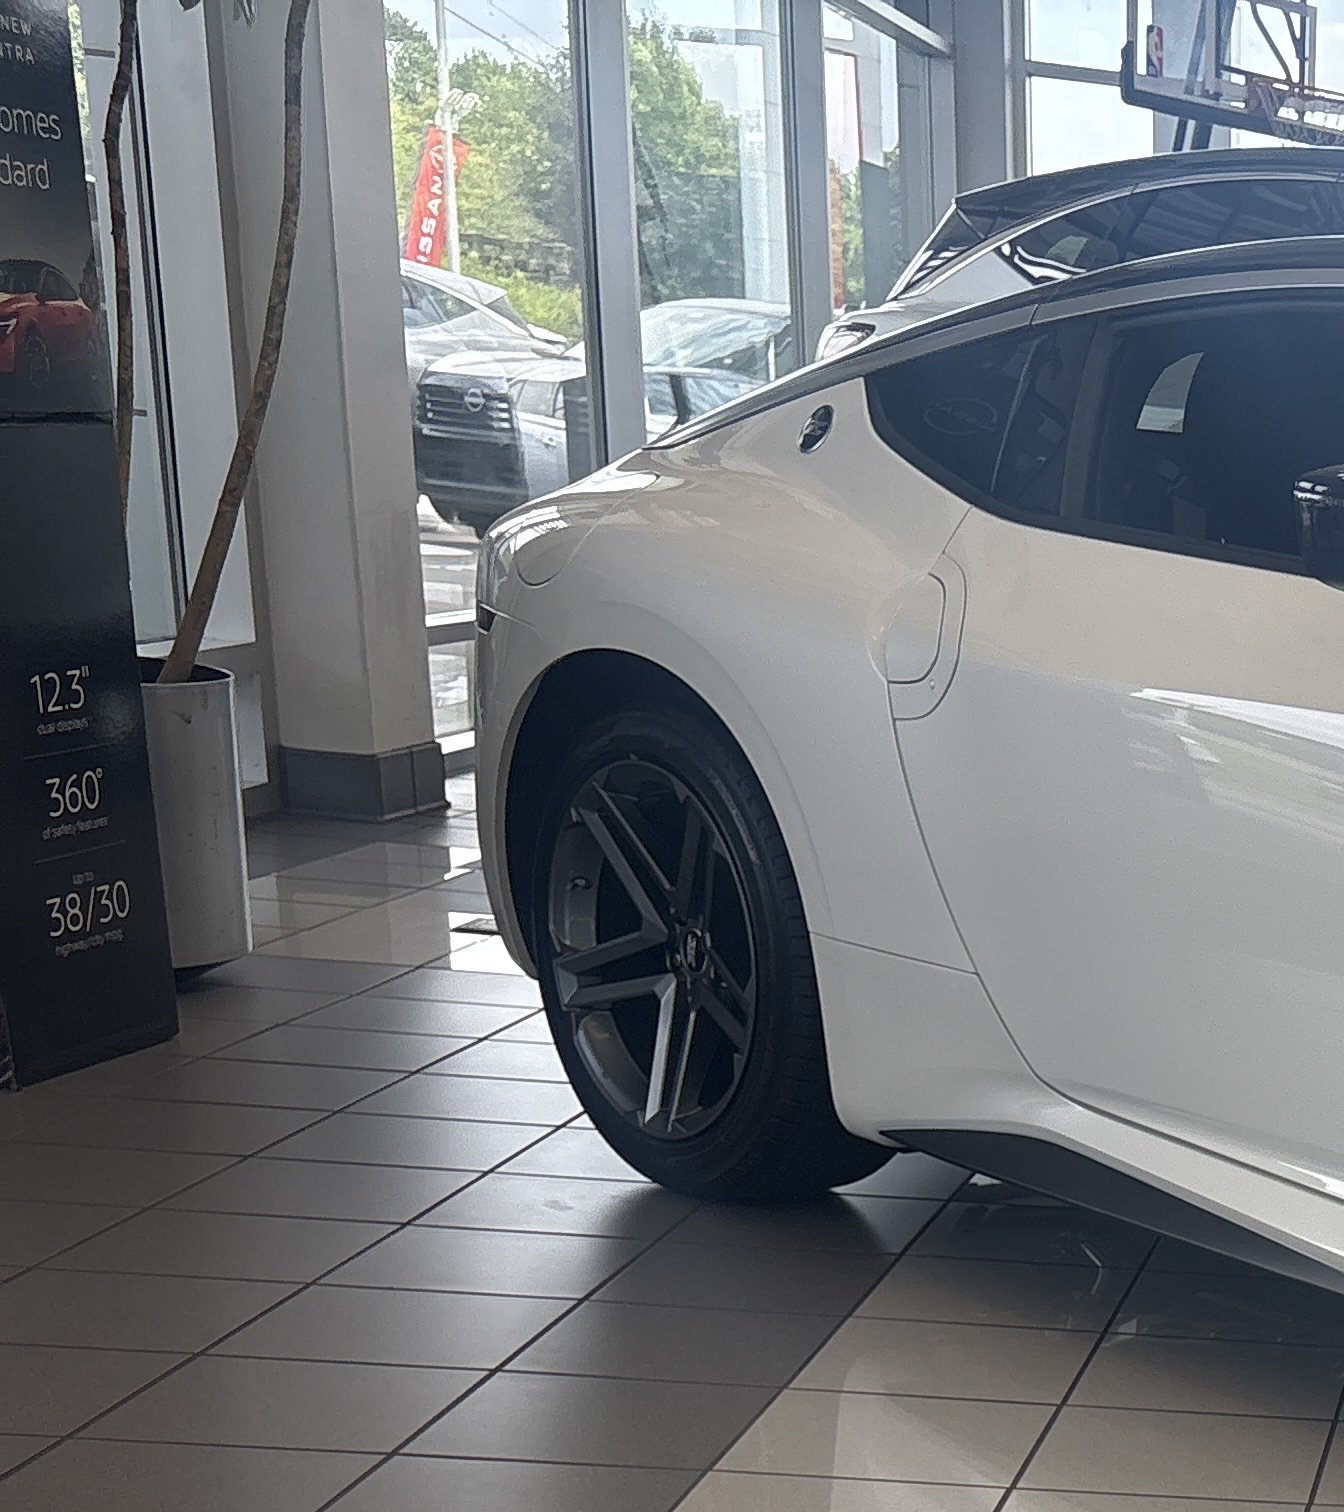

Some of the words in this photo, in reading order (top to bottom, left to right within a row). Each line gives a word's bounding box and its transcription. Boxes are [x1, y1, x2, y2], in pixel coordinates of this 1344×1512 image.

[0, 15, 33, 36] NEW
[0, 106, 62, 140] omes
[0, 152, 50, 190] dard
[30, 665, 91, 714] 12.3"
[45, 767, 103, 818] 360°
[45, 880, 130, 937] 38/30
